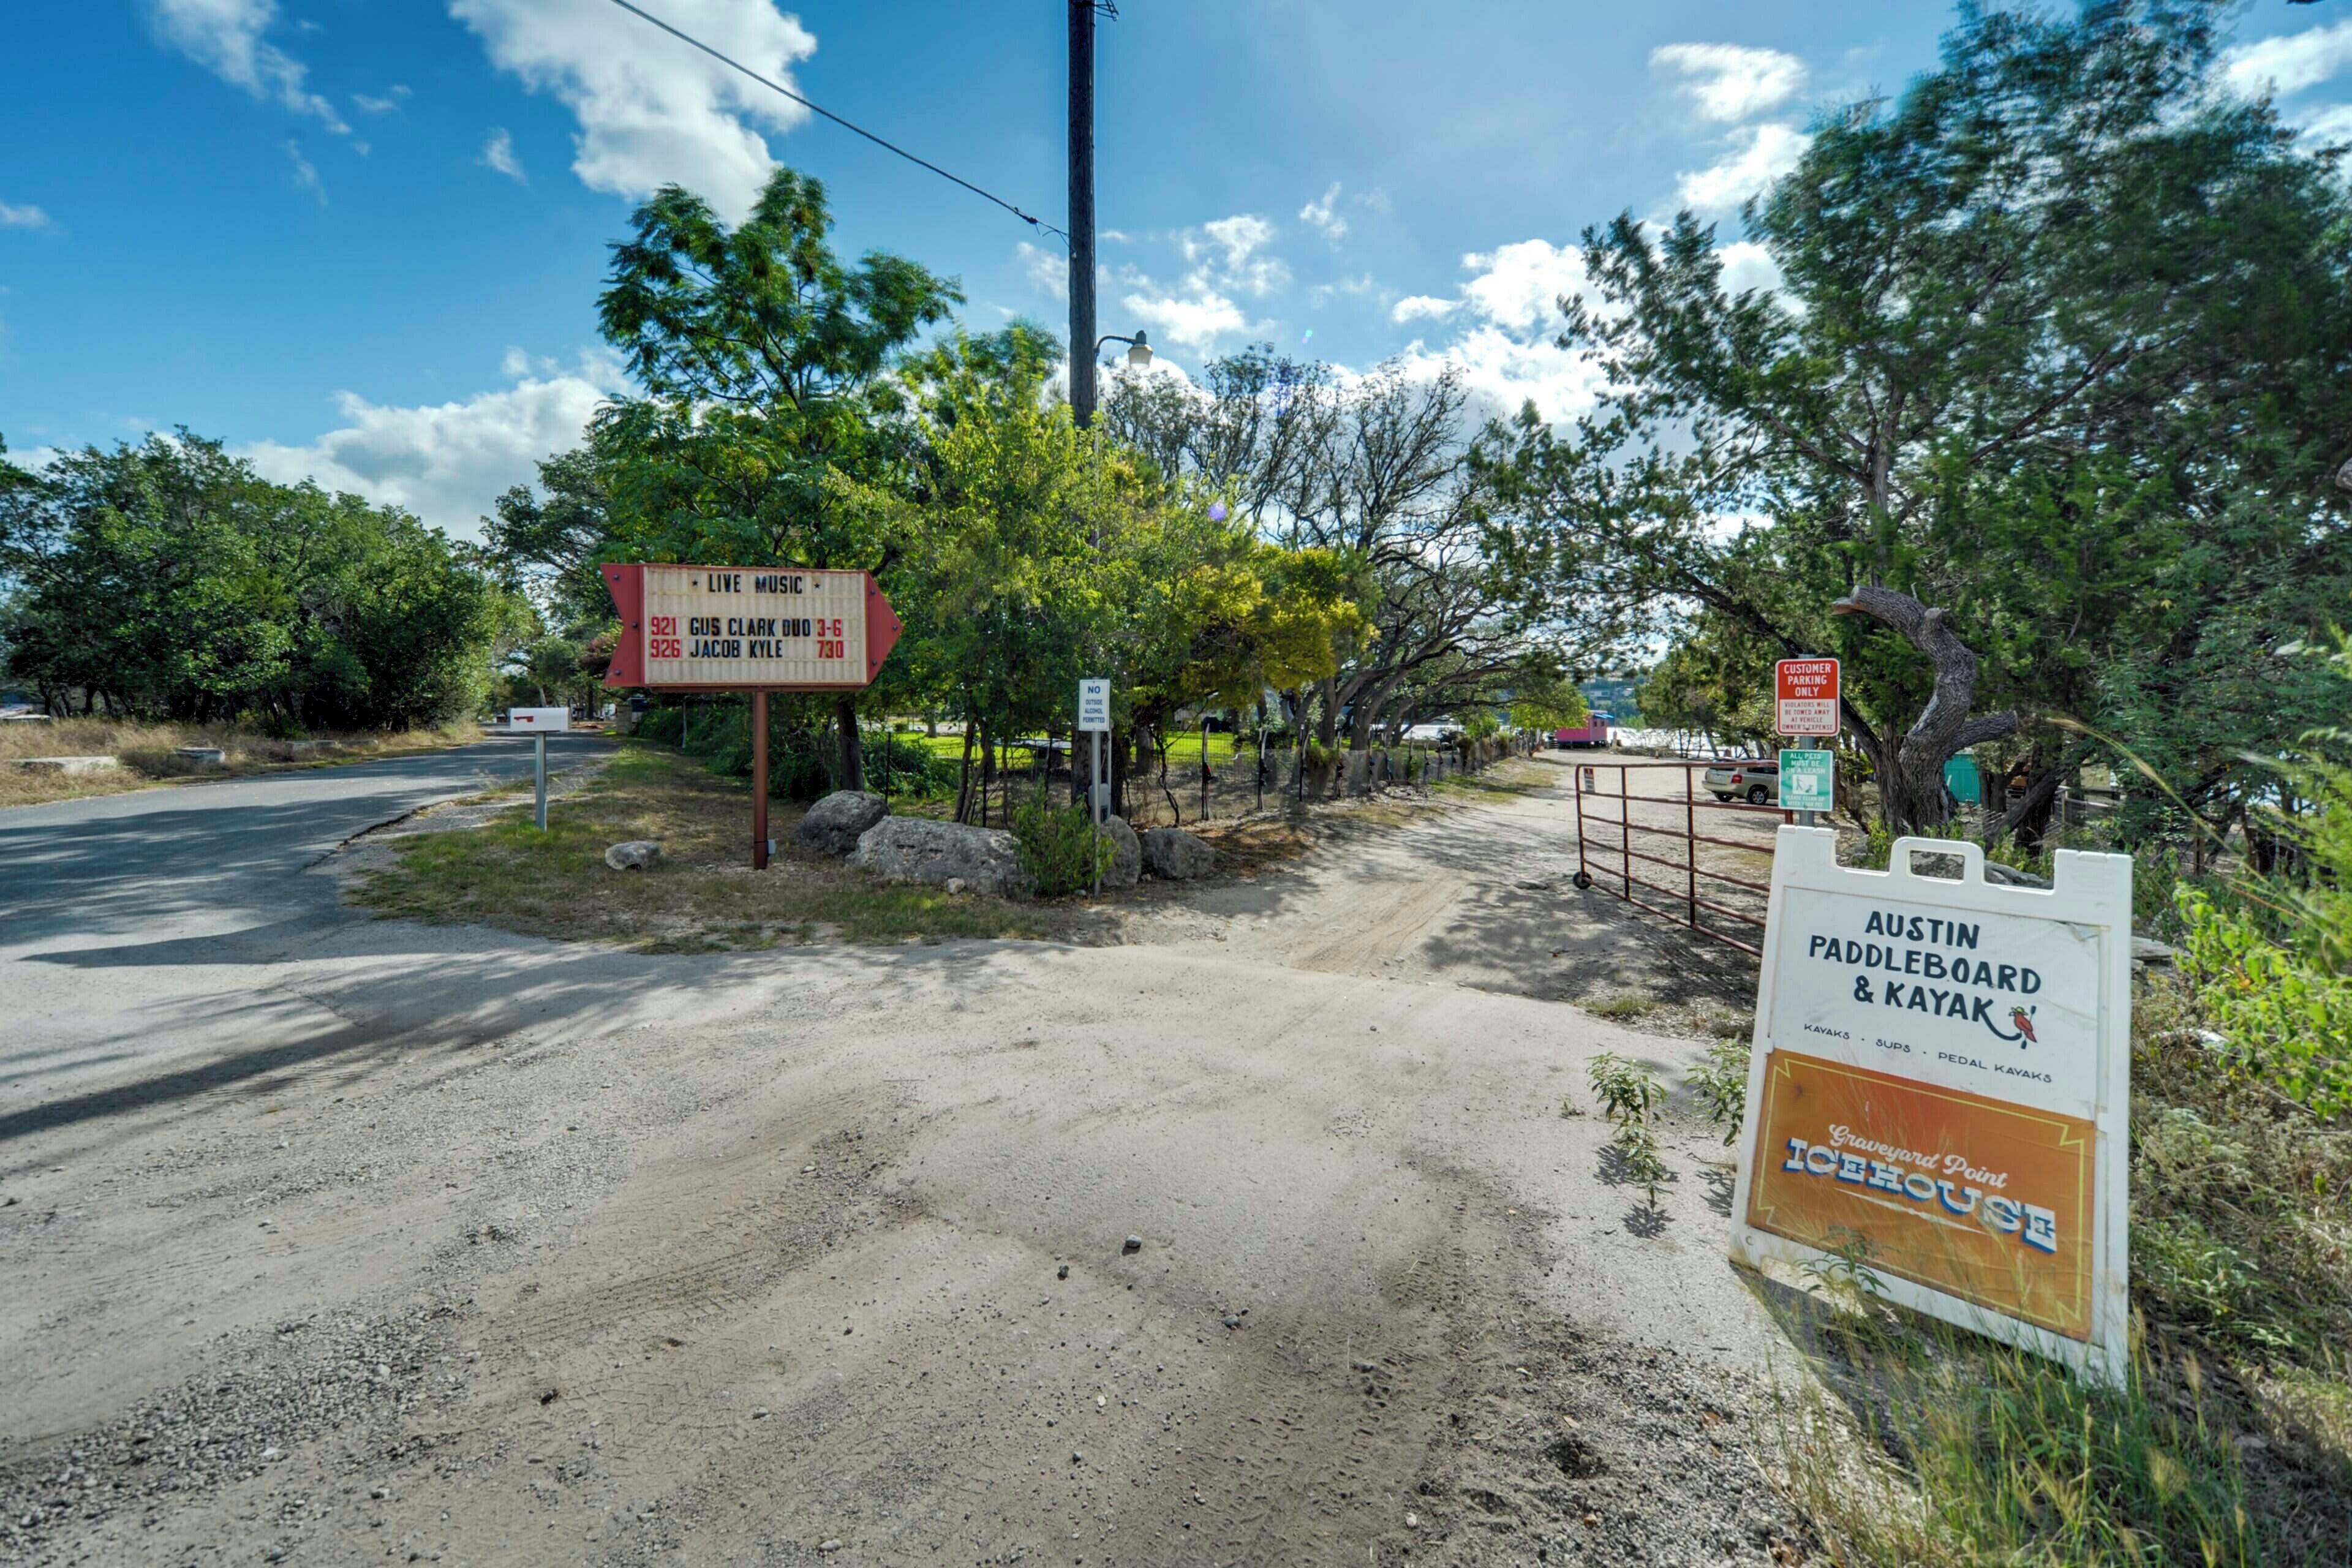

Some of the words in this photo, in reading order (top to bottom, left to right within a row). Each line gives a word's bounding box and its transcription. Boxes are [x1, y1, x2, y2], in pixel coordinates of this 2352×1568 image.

[709, 573, 741, 593] LIVE
[755, 575, 803, 594] MUSIC
[651, 617, 676, 636] 921
[690, 617, 720, 636] GUS
[729, 617, 775, 637] CLARK
[782, 619, 811, 638] DUO
[817, 619, 842, 638] 3-6
[651, 639, 681, 658] 926
[690, 639, 740, 658] JACOB
[749, 639, 783, 658] KYLE
[817, 640, 844, 659] 730
[1784, 663, 1831, 674] CUSTOMER
[1787, 675, 1827, 685] PARKING
[1795, 687, 1819, 697] ONLY
[1864, 910, 1980, 949] AUSTIN
[1808, 934, 2041, 995] PADDLEBOARD
[1853, 975, 1874, 1004] &
[1885, 981, 2022, 1041] KAYAK
[1804, 1023, 1850, 1040] KAYAKS
[1875, 1039, 1912, 1054] SUPS
[1939, 1052, 1988, 1070] PEDAL
[1994, 1063, 2052, 1084] KAYAKS
[1829, 1123, 1941, 1170] Graveyard
[1943, 1154, 2008, 1189] Point
[1783, 1137, 2057, 1254] ICEHOUSE
